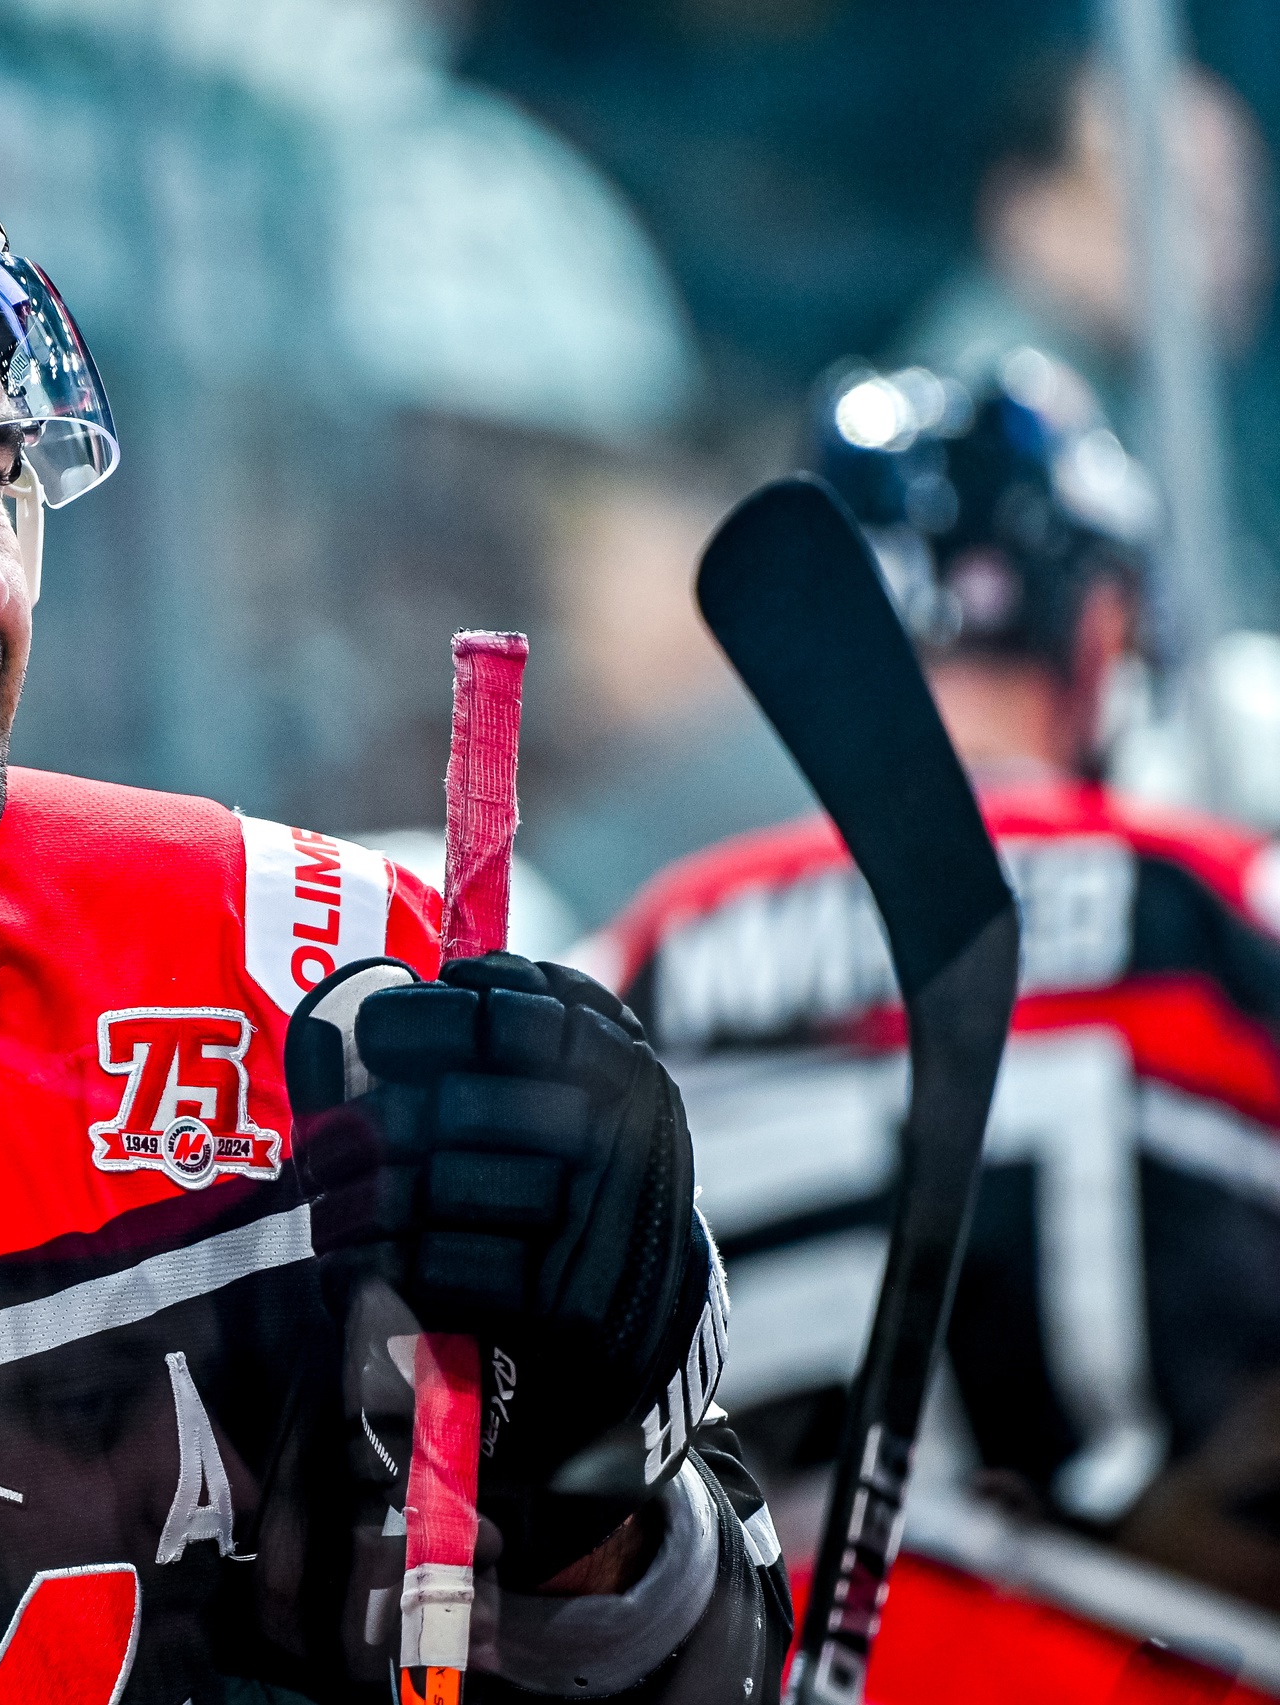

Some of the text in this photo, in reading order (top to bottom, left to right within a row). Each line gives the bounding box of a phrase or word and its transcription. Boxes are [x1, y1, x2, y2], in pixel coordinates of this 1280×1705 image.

[290, 826, 342, 994] OLIMP
[109, 1018, 243, 1134] 75
[125, 1135, 159, 1154] 1949
[218, 1138, 251, 1157] 2024
[155, 1351, 234, 1564] A
